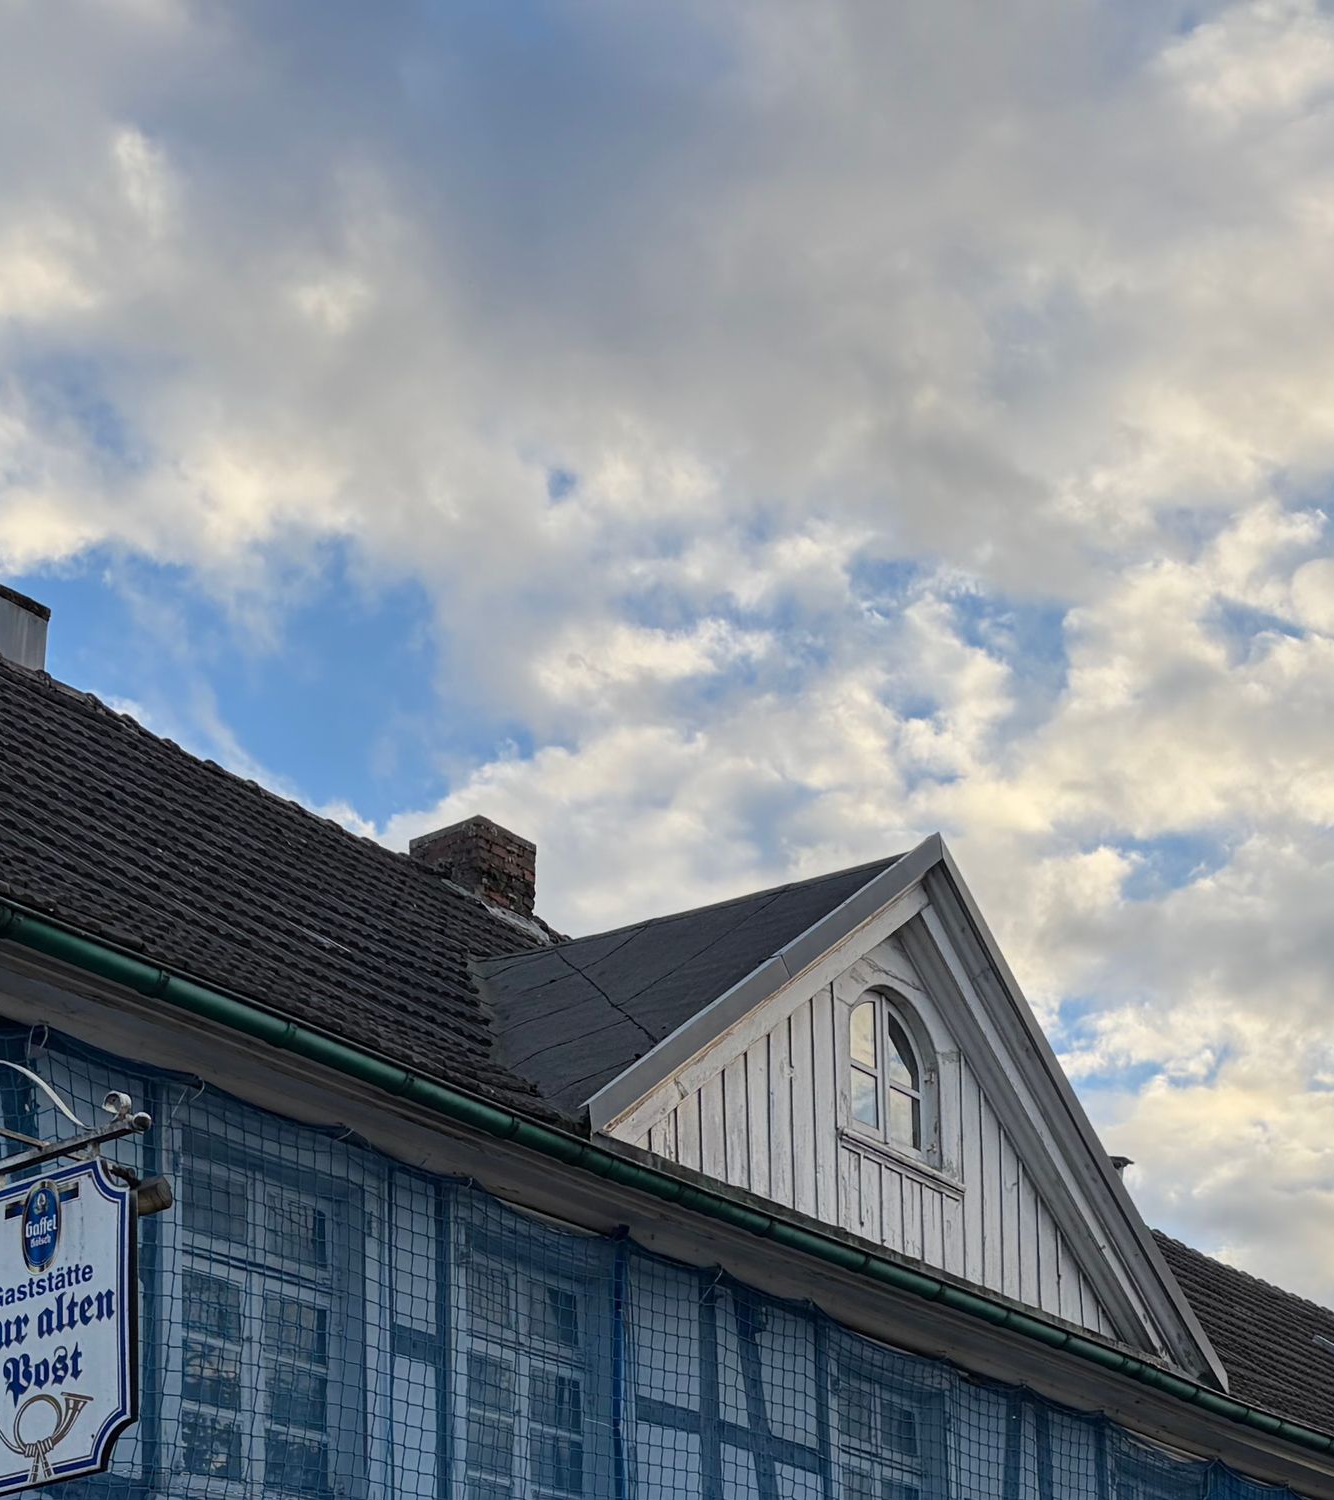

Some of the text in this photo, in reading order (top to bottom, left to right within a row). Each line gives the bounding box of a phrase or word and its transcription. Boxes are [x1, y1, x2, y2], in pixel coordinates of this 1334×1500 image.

[25, 1213, 58, 1239] Gaffel
[37, 1288, 116, 1340] alten
[2, 1342, 84, 1408] Post
